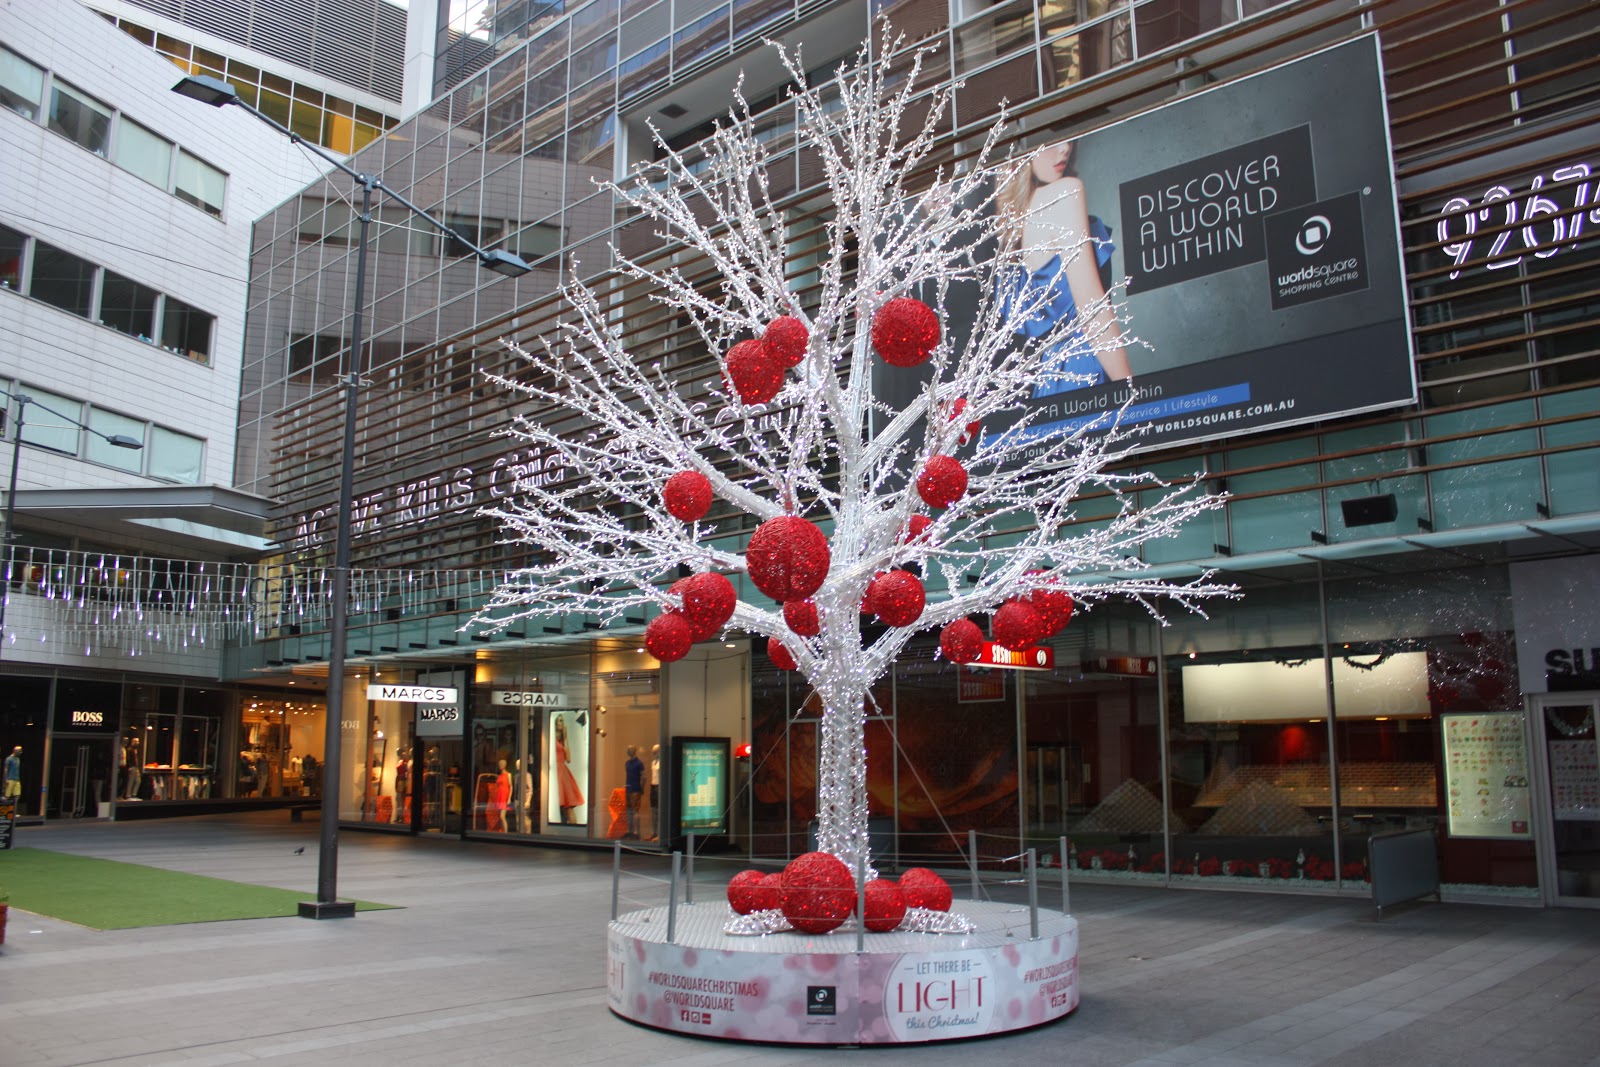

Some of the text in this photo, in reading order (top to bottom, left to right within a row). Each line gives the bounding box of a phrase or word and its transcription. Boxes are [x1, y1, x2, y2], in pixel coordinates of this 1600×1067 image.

[1138, 155, 1280, 218] DISCOVER
[1140, 186, 1278, 245] A WORLD
[1141, 223, 1243, 272] WITHIN
[1278, 258, 1358, 286] worldsquare
[1279, 281, 1322, 297] SHOPPING
[1049, 404, 1059, 418] A
[1064, 396, 1108, 415] World
[1123, 403, 1160, 421] Service
[1171, 394, 1218, 412] Lifestyle
[1023, 447, 1046, 459] JOIN
[1091, 430, 1132, 445] INSDER
[1155, 399, 1295, 434] WORLDSQUARE.COM.AU
[382, 687, 447, 701] MARCS
[72, 711, 103, 723] BOSS
[421, 707, 459, 722] MARCS
[916, 959, 972, 975] LET THERE BE
[648, 971, 759, 997] #WORLDSQUARECHRISTMAS
[897, 976, 987, 1013] LIGHT
[664, 989, 735, 1012] @WORLDSQUARE
[906, 1011, 980, 1029] this Christmas!
